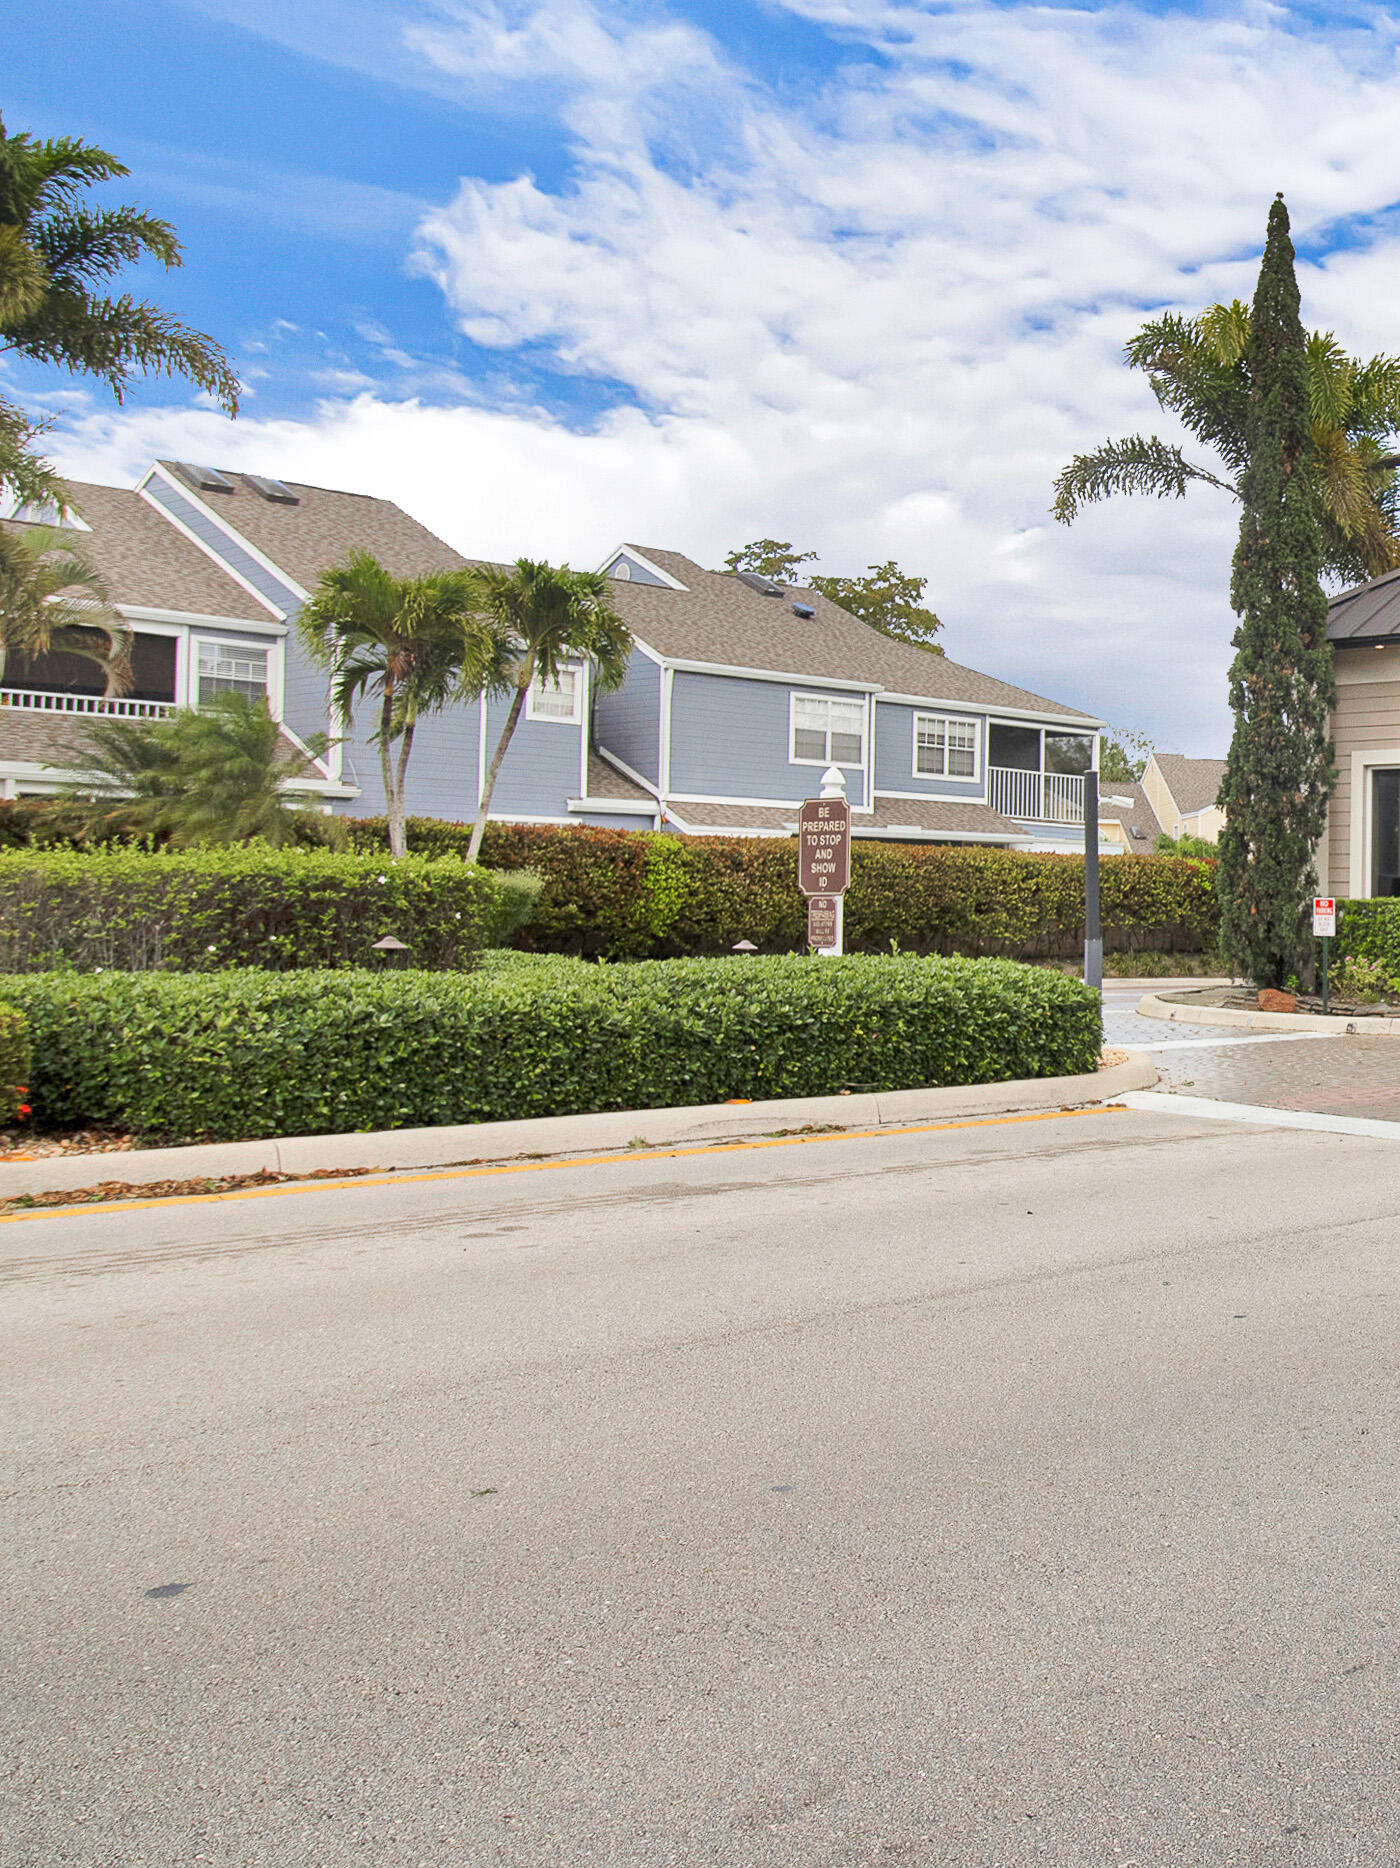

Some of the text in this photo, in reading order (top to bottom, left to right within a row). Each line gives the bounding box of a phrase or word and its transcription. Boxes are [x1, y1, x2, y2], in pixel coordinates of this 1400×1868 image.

[818, 807, 830, 818] BE
[802, 820, 846, 832] PREPARED
[807, 834, 842, 846] TO STOP
[815, 848, 833, 860] AND
[811, 862, 836, 874] SHOW
[819, 876, 828, 888] ID
[818, 900, 827, 909] NO
